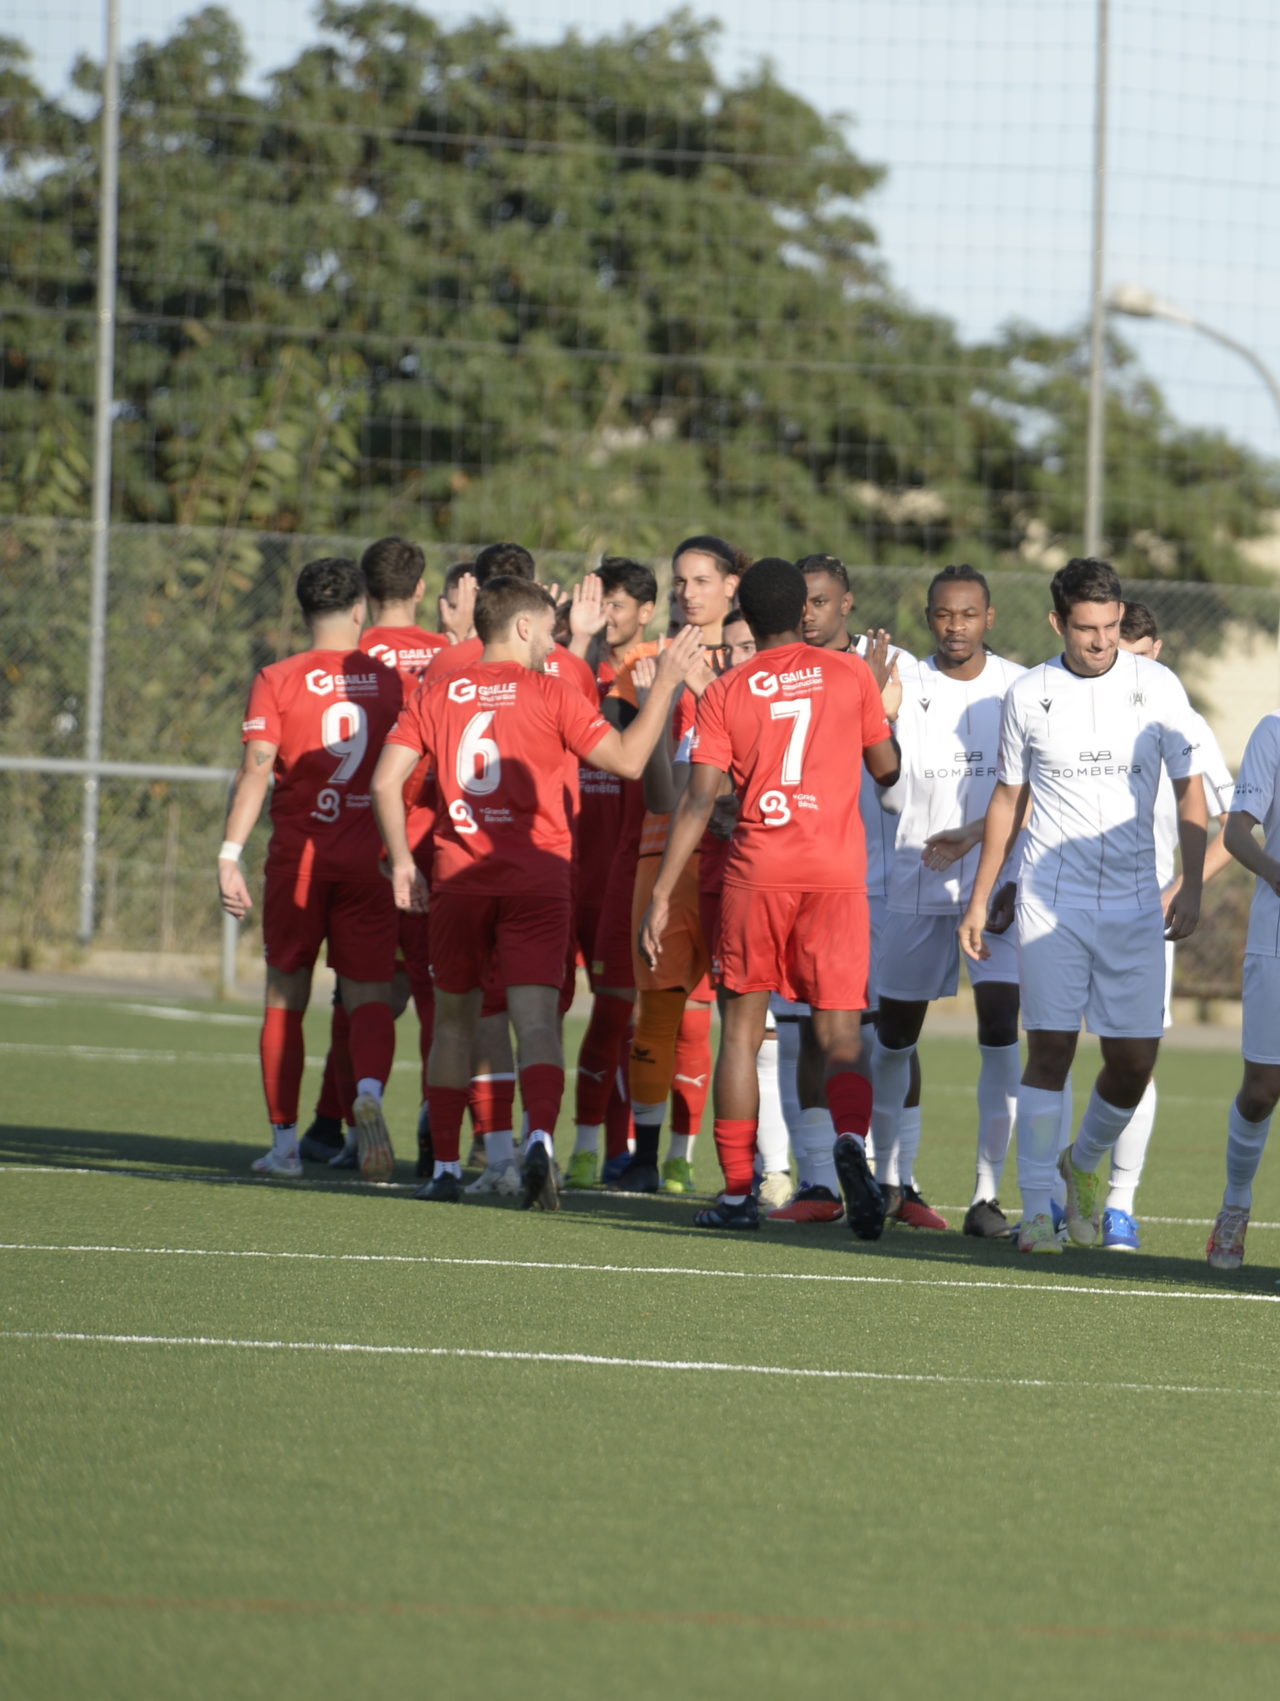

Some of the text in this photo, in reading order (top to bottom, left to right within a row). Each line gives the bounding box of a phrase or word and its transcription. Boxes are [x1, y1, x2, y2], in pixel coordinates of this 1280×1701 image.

[335, 673, 377, 685] GAILLE
[779, 666, 822, 684] GAILLE
[478, 682, 517, 696] GAILLE
[321, 701, 368, 784] 9
[770, 698, 812, 786] 7
[456, 710, 501, 796] 6
[924, 767, 997, 778] BOMBER
[1051, 765, 1142, 778] BOMBERG
